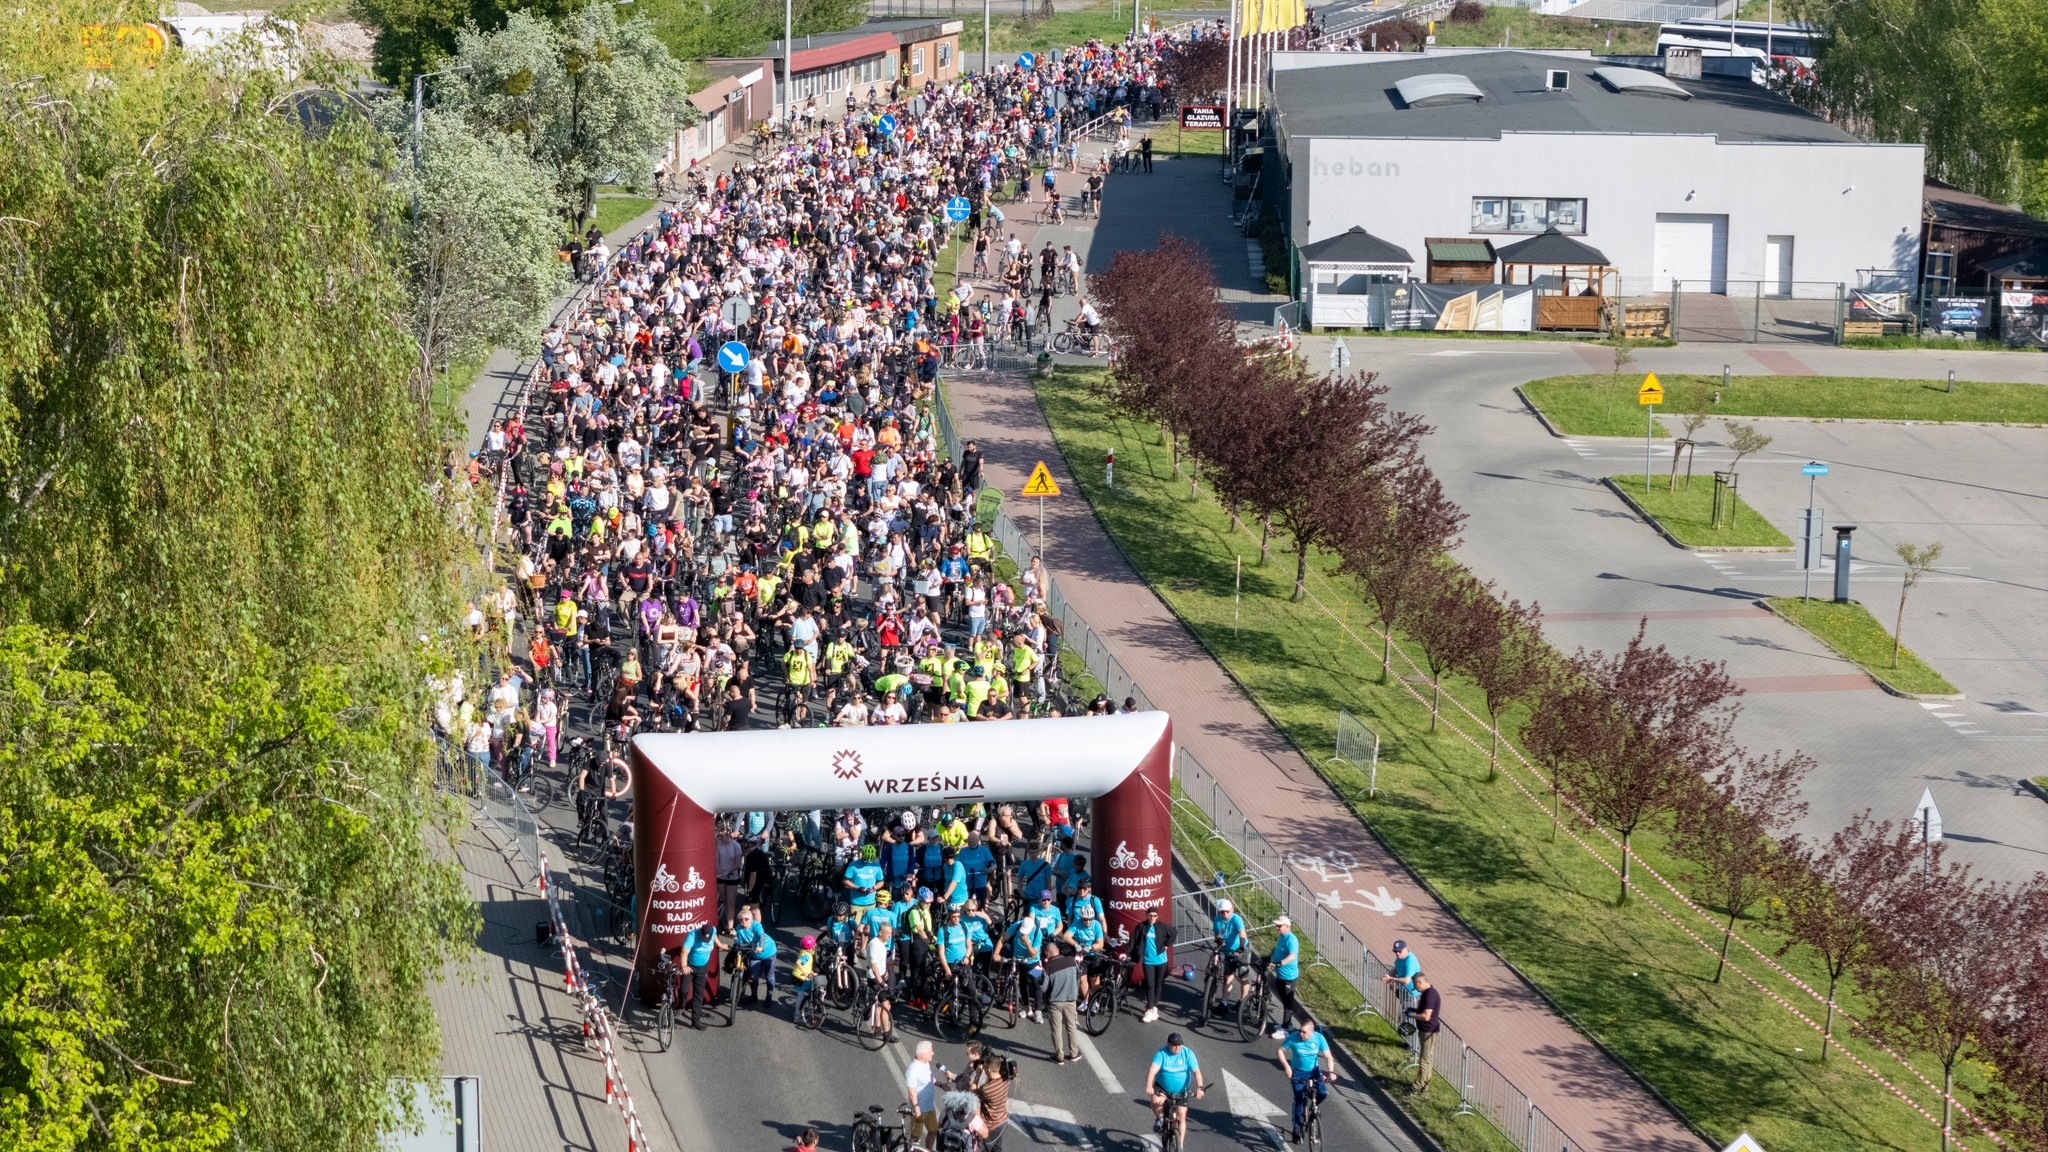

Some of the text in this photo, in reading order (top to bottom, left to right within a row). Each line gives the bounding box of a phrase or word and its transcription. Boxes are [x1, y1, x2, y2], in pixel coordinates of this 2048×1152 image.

[1313, 156, 1400, 176] heban
[1842, 540, 1848, 548] P
[864, 772, 985, 794] WRZEŚNIA
[1111, 874, 1163, 886] RODZINNY
[1126, 889, 1151, 898] RAJD
[652, 896, 705, 909] RODZINNY
[1110, 897, 1165, 910] ROWEROWY
[667, 912, 693, 922] RAJD
